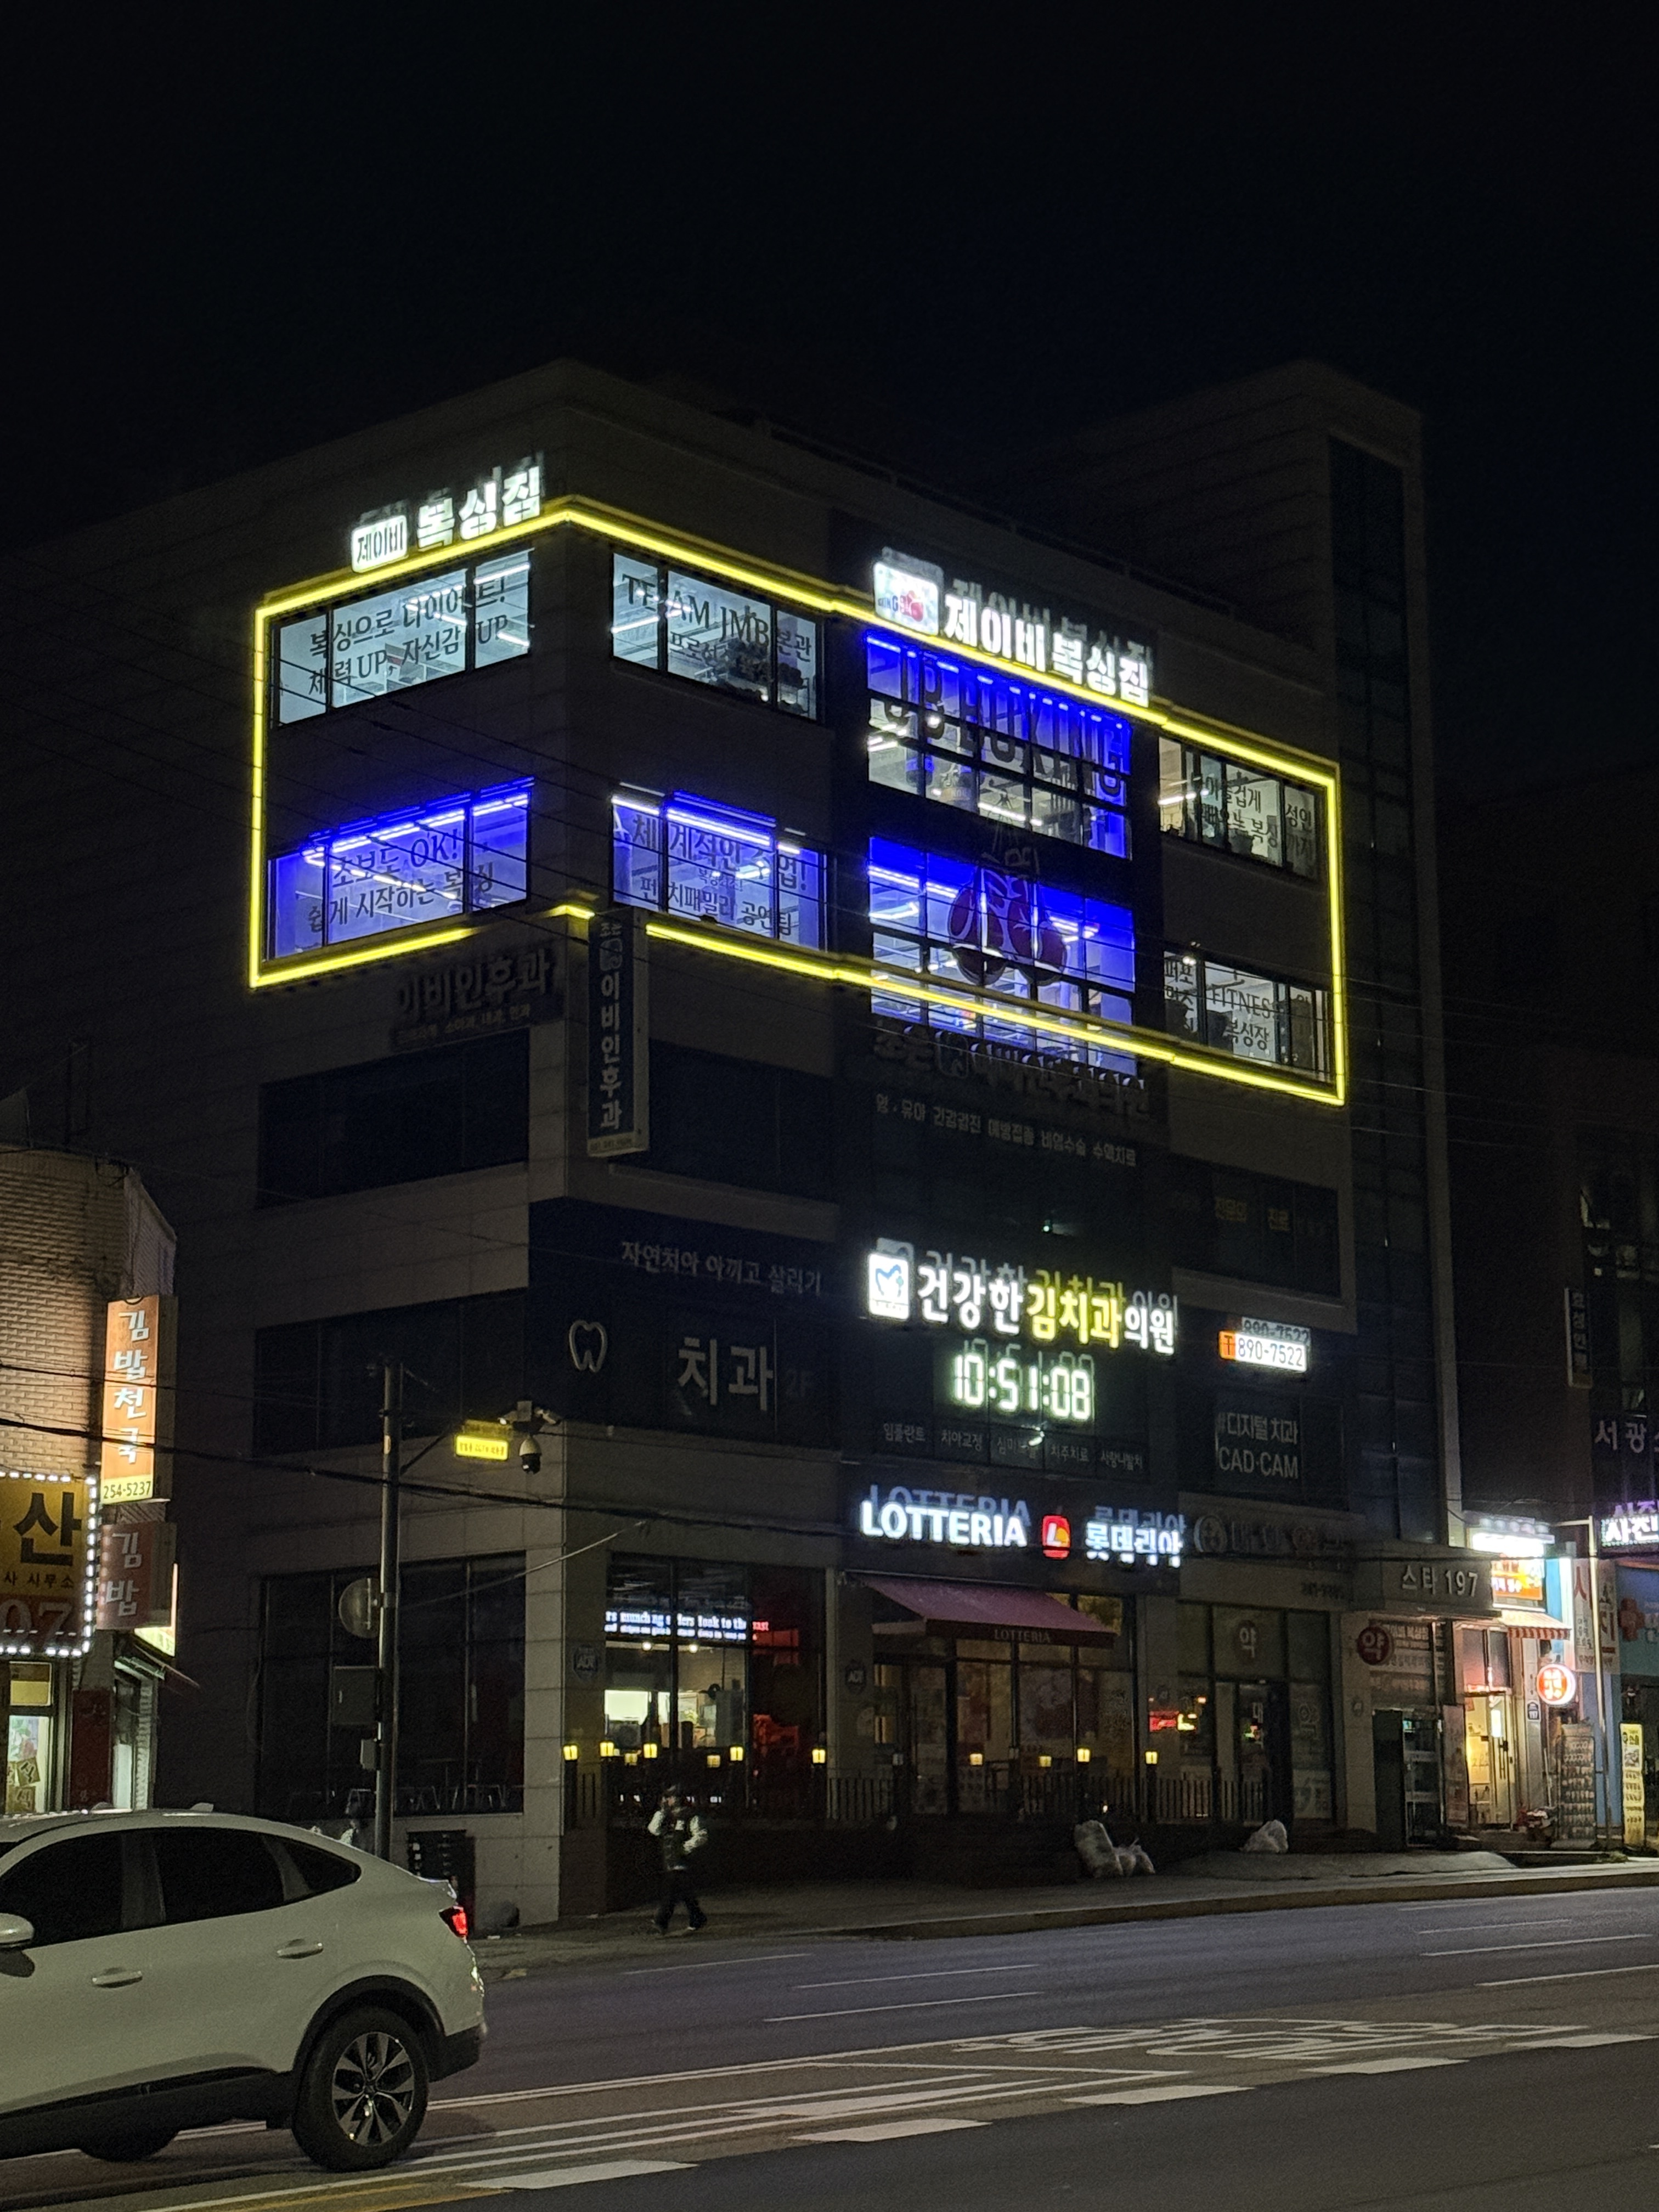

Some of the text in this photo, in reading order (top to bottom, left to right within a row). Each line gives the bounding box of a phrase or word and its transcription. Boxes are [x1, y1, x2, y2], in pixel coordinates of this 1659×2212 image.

[417, 466, 541, 550] 복싱짐
[311, 608, 396, 658] 복싱으로
[622, 574, 769, 647] TEAM JMB
[309, 659, 352, 696] 체력
[402, 627, 461, 666] 자신감
[477, 614, 508, 644] UP
[944, 594, 1149, 708] 제이비 복싱짐
[633, 814, 741, 872] 체계적인
[1251, 818, 1278, 848] 복싱
[1285, 804, 1313, 833] 성인
[332, 828, 458, 888] 초보도 OK!
[356, 878, 435, 918] 시작하는
[443, 862, 494, 900] 복싱
[639, 876, 792, 936] 펀치패밀리 공연팀
[1211, 983, 1276, 1019] FITNES
[599, 971, 623, 1130] 이비인후과
[1222, 1018, 1269, 1051] 복싱장
[621, 1240, 822, 1297] 자연치아 아끼고 살리기
[676, 1336, 774, 1412] 치과
[1238, 1338, 1304, 1368] 890-7522
[114, 1310, 150, 1465] 김밥천국
[952, 1353, 1091, 1420] 10:51:08
[882, 1423, 927, 1444] 임플란트
[940, 1429, 983, 1452] 치아교정
[1270, 1417, 1298, 1445] 치과
[13, 1491, 82, 1567] 산
[861, 1500, 1028, 1548] LOTTERIA
[1085, 1521, 1182, 1568] 롯데리아
[106, 1533, 142, 1616] 김밥
[1402, 1564, 1437, 1595] 스타
[1444, 1568, 1479, 1598] 197
[994, 1628, 1052, 1645] LOTTERIA
[1362, 1630, 1386, 1661] 약
